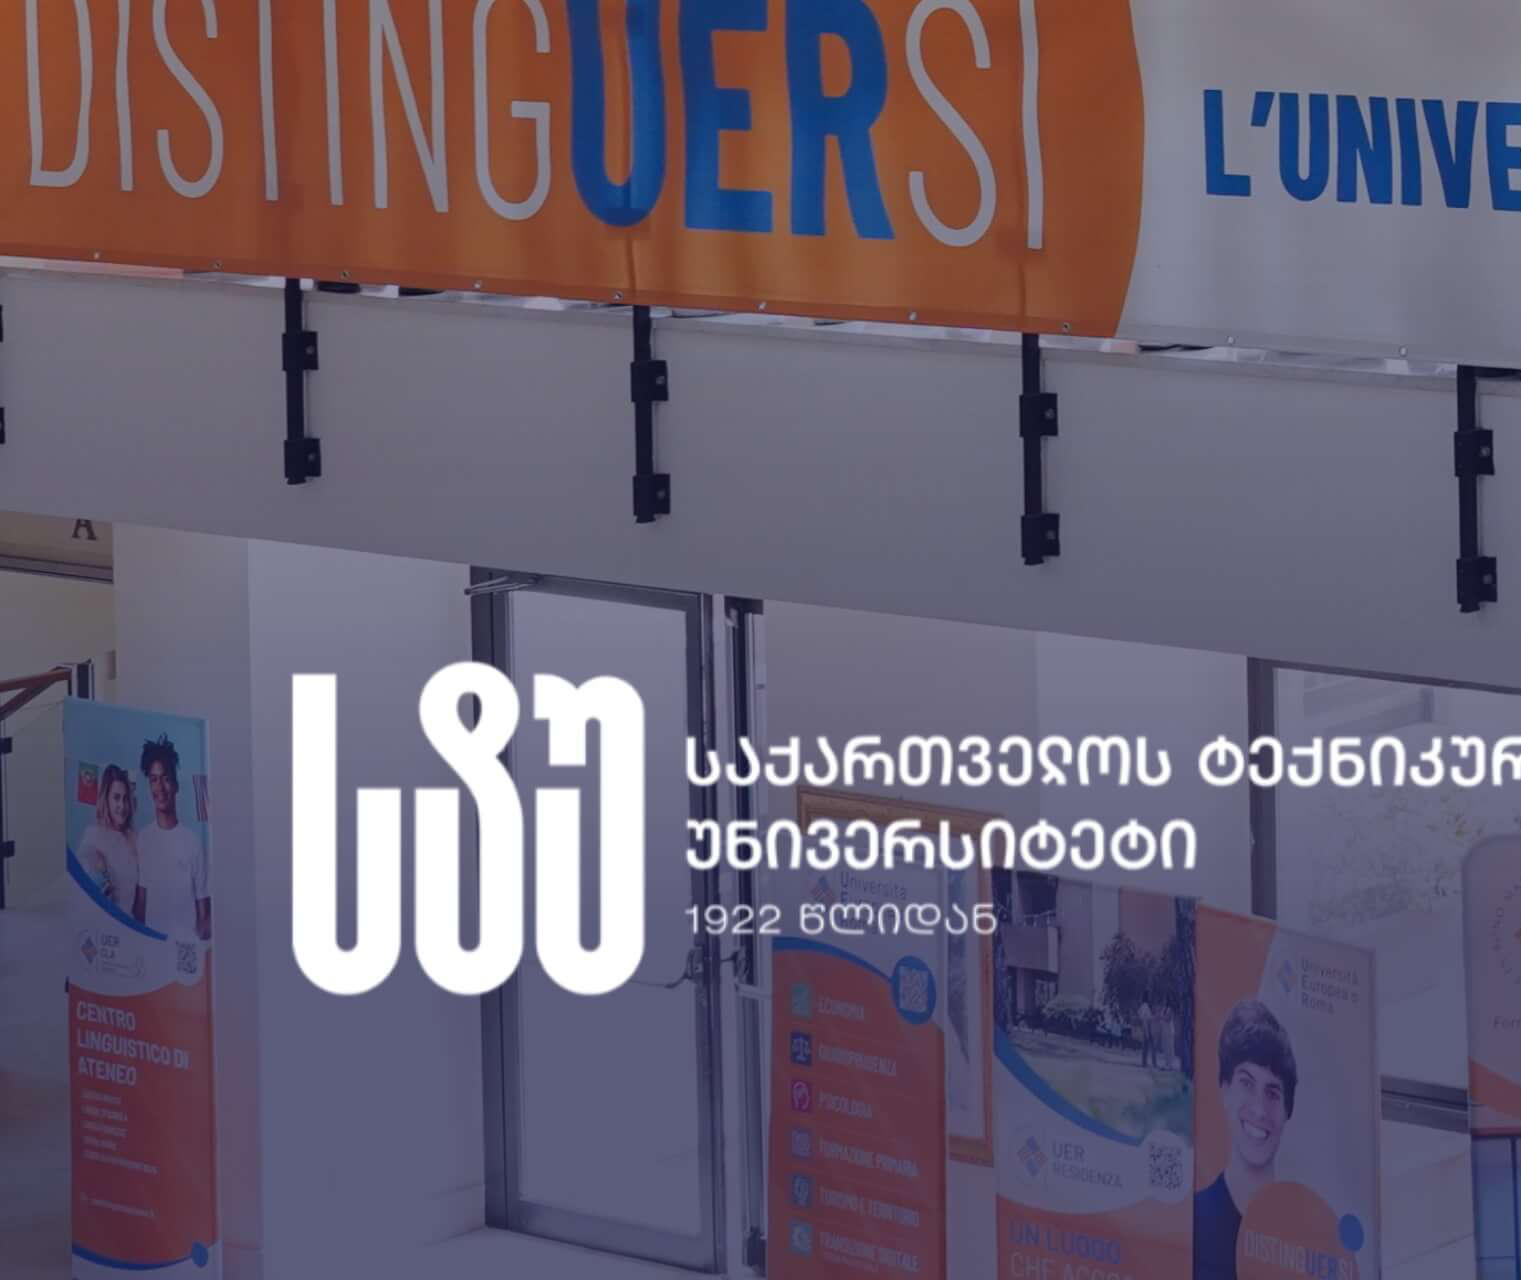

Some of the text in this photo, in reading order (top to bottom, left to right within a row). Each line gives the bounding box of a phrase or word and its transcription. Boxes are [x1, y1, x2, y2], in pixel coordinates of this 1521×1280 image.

[77, 1000, 137, 1032] CENTRO
[77, 1026, 171, 1066] LINGUISTICO
[78, 1056, 137, 1088] ATENEO
[1052, 1140, 1085, 1162] UER
